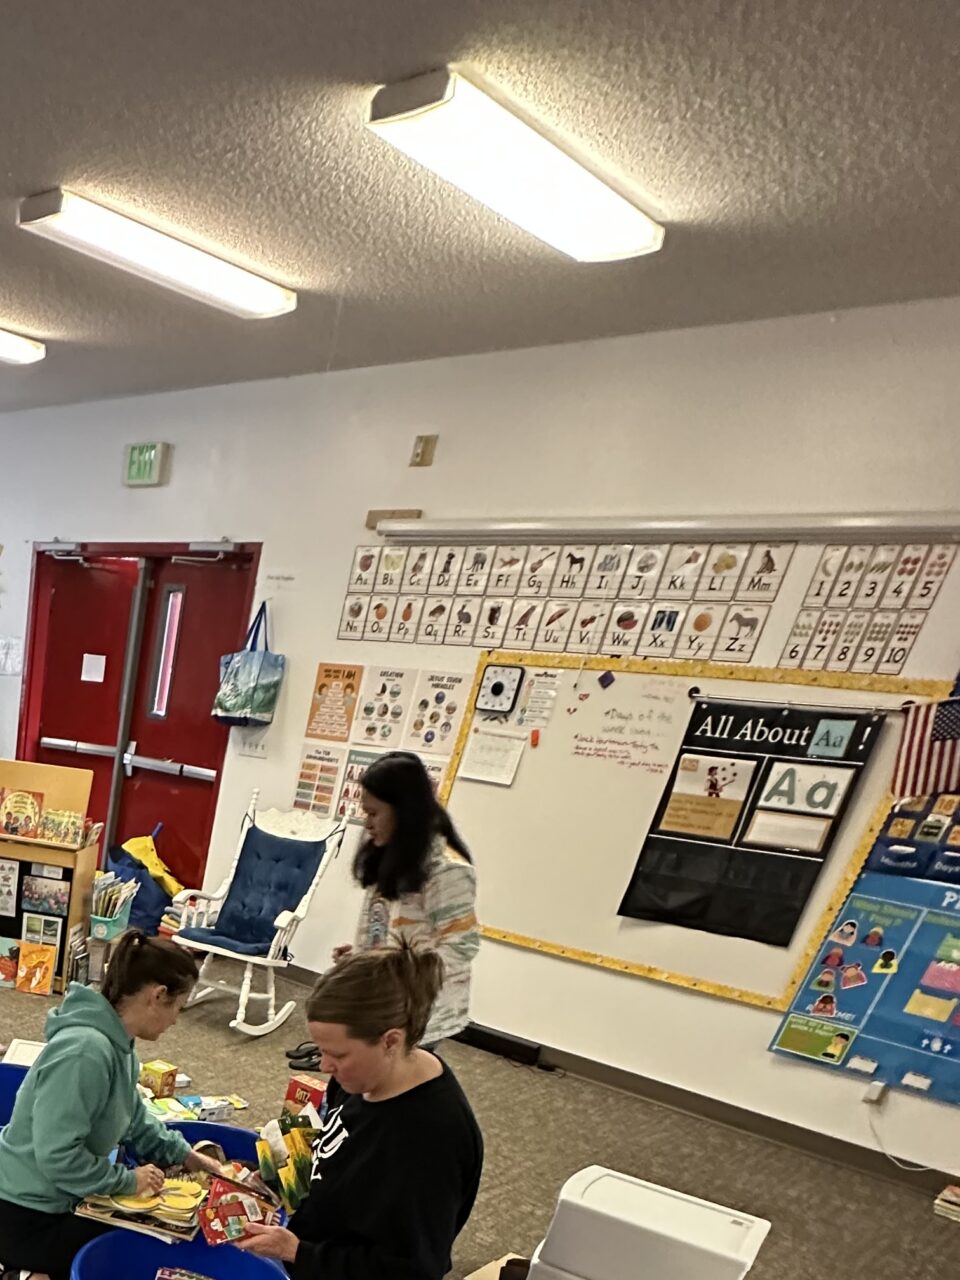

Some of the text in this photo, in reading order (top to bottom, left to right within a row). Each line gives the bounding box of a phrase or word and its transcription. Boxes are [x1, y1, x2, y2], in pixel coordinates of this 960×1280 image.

[355, 574, 368, 585] Aa
[382, 573, 394, 585] Bb
[409, 575, 422, 586] Cc
[436, 575, 450, 587] Dd
[466, 574, 478, 587] Ee
[496, 575, 510, 587] Ff
[528, 576, 542, 594] Gg
[560, 575, 576, 589] Hh
[631, 576, 646, 596] Jj
[668, 575, 685, 590] Kk
[708, 576, 724, 591] Ll
[747, 576, 771, 591] Mm
[814, 581, 934, 598] 1 2 3 4 5
[346, 623, 358, 632] Nn
[397, 624, 409, 639] Pp
[424, 624, 439, 642] Qq
[453, 625, 466, 637] Rr
[482, 627, 496, 639] Ss
[514, 628, 526, 640] Tt
[544, 629, 558, 643] Uu
[612, 632, 631, 646] Ww
[649, 634, 666, 648] Xx
[688, 636, 705, 656] Yy
[725, 638, 746, 652] Zz
[790, 644, 906, 663] 6 7 8 9 10
[695, 715, 735, 739] All
[733, 718, 811, 746] About
[814, 729, 844, 748] Aa
[295, 1088, 311, 1104] RITZ
